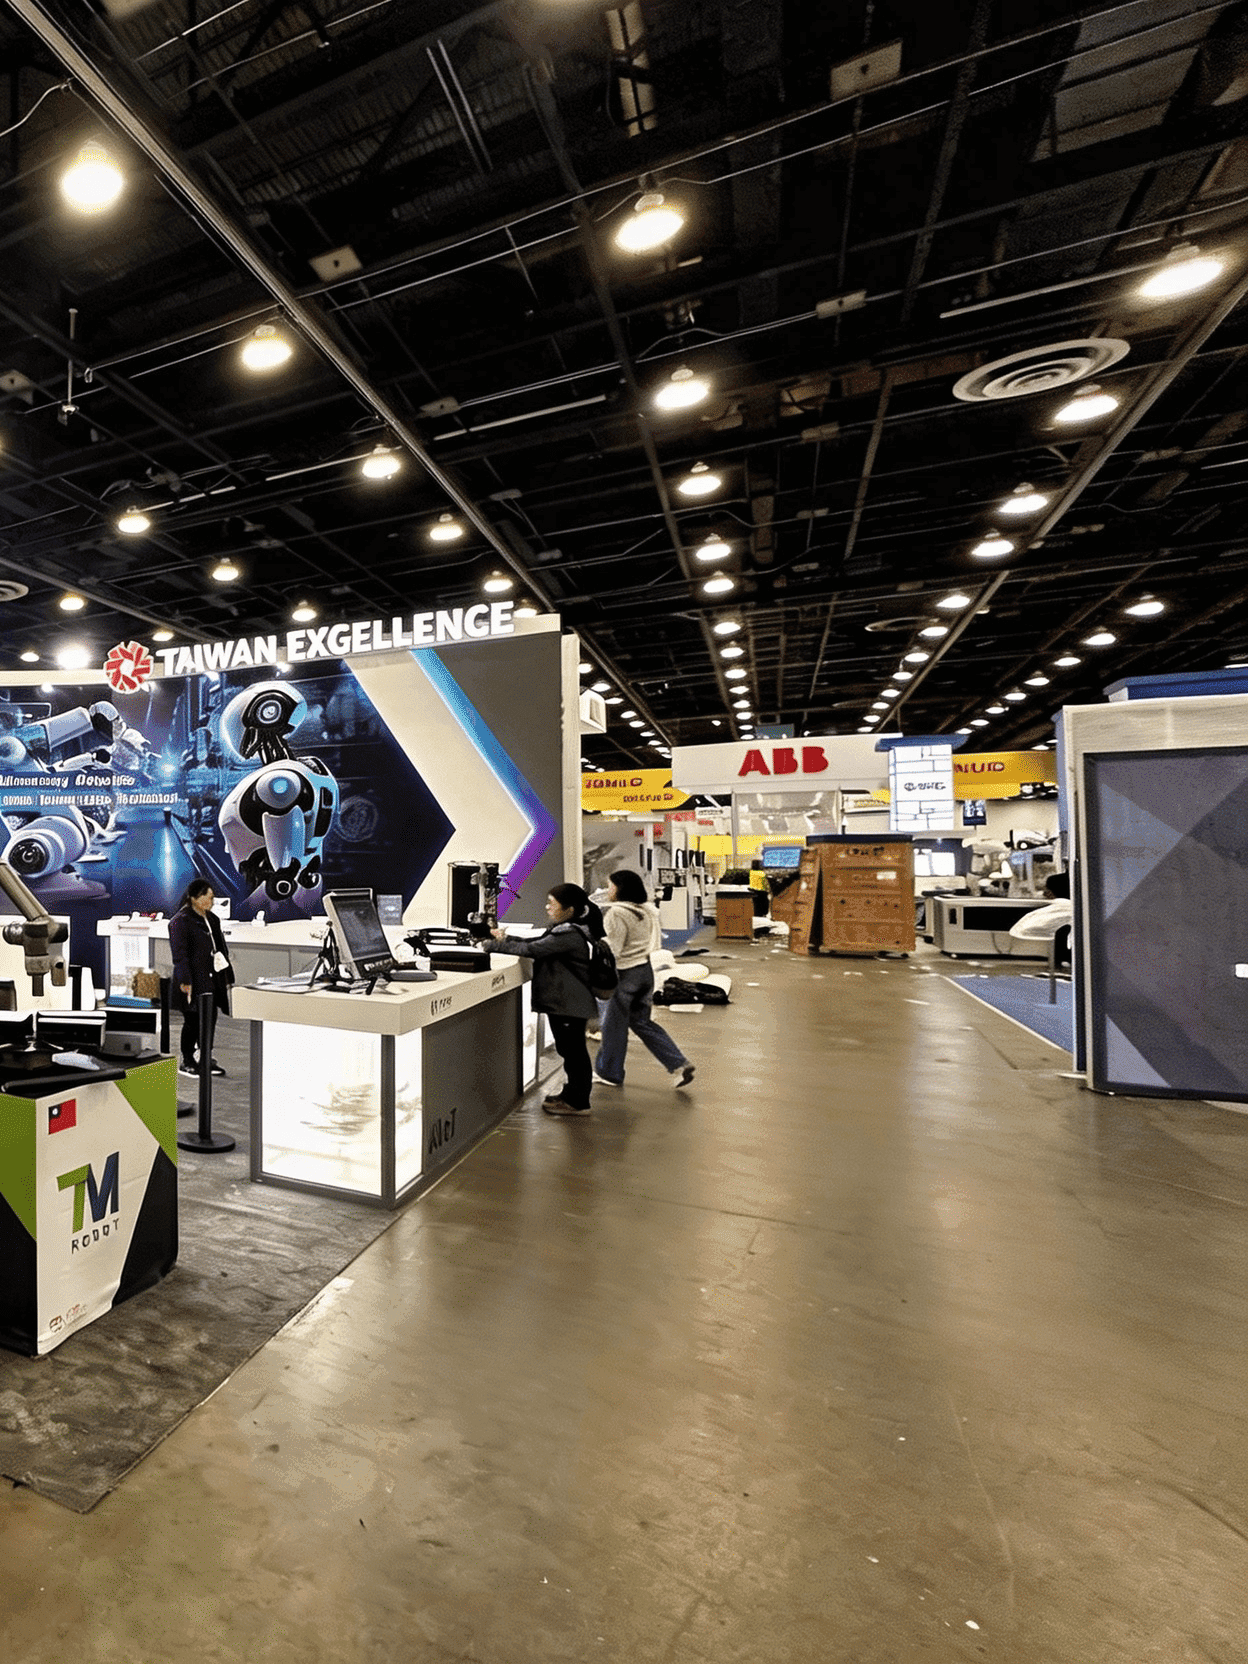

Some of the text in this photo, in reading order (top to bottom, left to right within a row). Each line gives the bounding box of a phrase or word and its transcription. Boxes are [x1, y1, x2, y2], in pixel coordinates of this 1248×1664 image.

[155, 635, 277, 676] TAIWAN
[737, 746, 829, 777] ABB
[56, 1151, 119, 1234] TM
